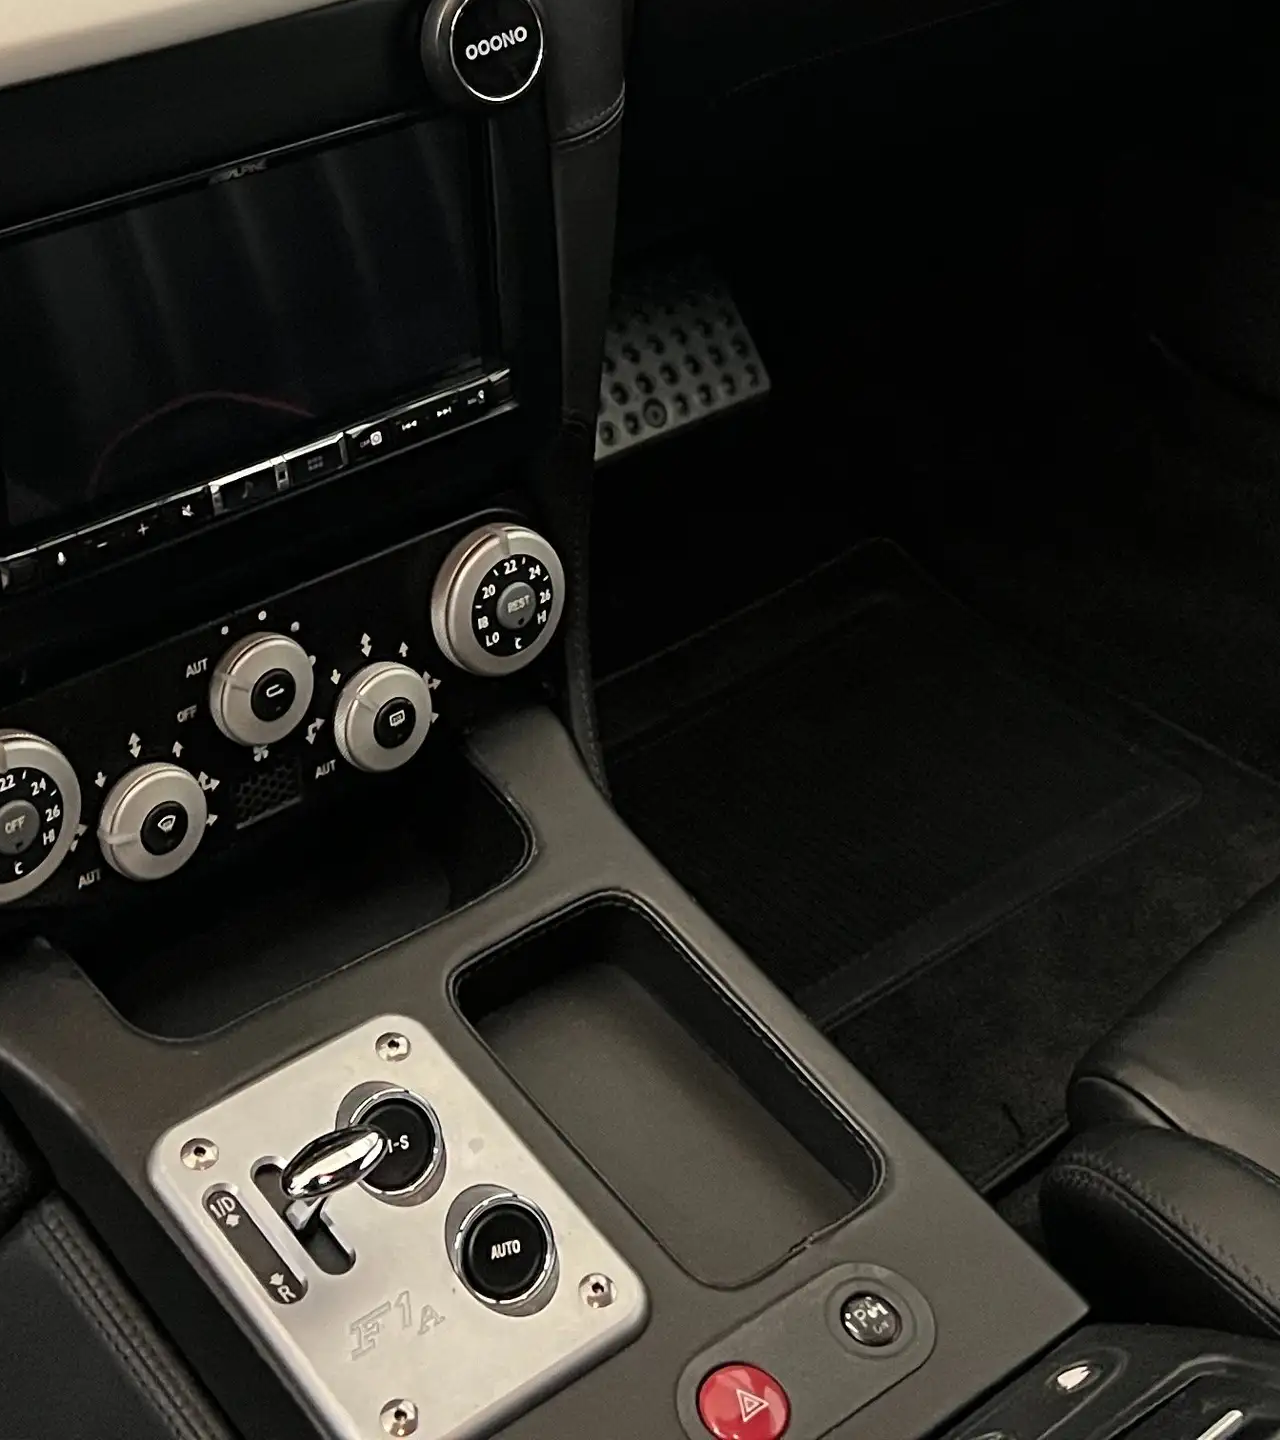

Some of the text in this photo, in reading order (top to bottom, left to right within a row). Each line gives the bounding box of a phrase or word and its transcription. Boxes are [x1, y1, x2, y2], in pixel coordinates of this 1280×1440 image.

[465, 26, 528, 60] OOONO
[503, 559, 518, 575] 22
[528, 564, 541, 580] 24
[481, 584, 496, 600] 20
[539, 589, 551, 604] 26
[507, 594, 531, 614] REST
[485, 631, 500, 648] LO
[186, 657, 208, 679] AUT
[176, 704, 197, 723] OFF
[315, 758, 337, 780] AUT
[30, 777, 47, 796] 24
[45, 805, 61, 822] 26
[4, 815, 25, 834] OFF
[42, 828, 56, 846] HI
[78, 868, 101, 890] AUT
[491, 1239, 521, 1260] AUTO
[277, 1285, 296, 1302] R
